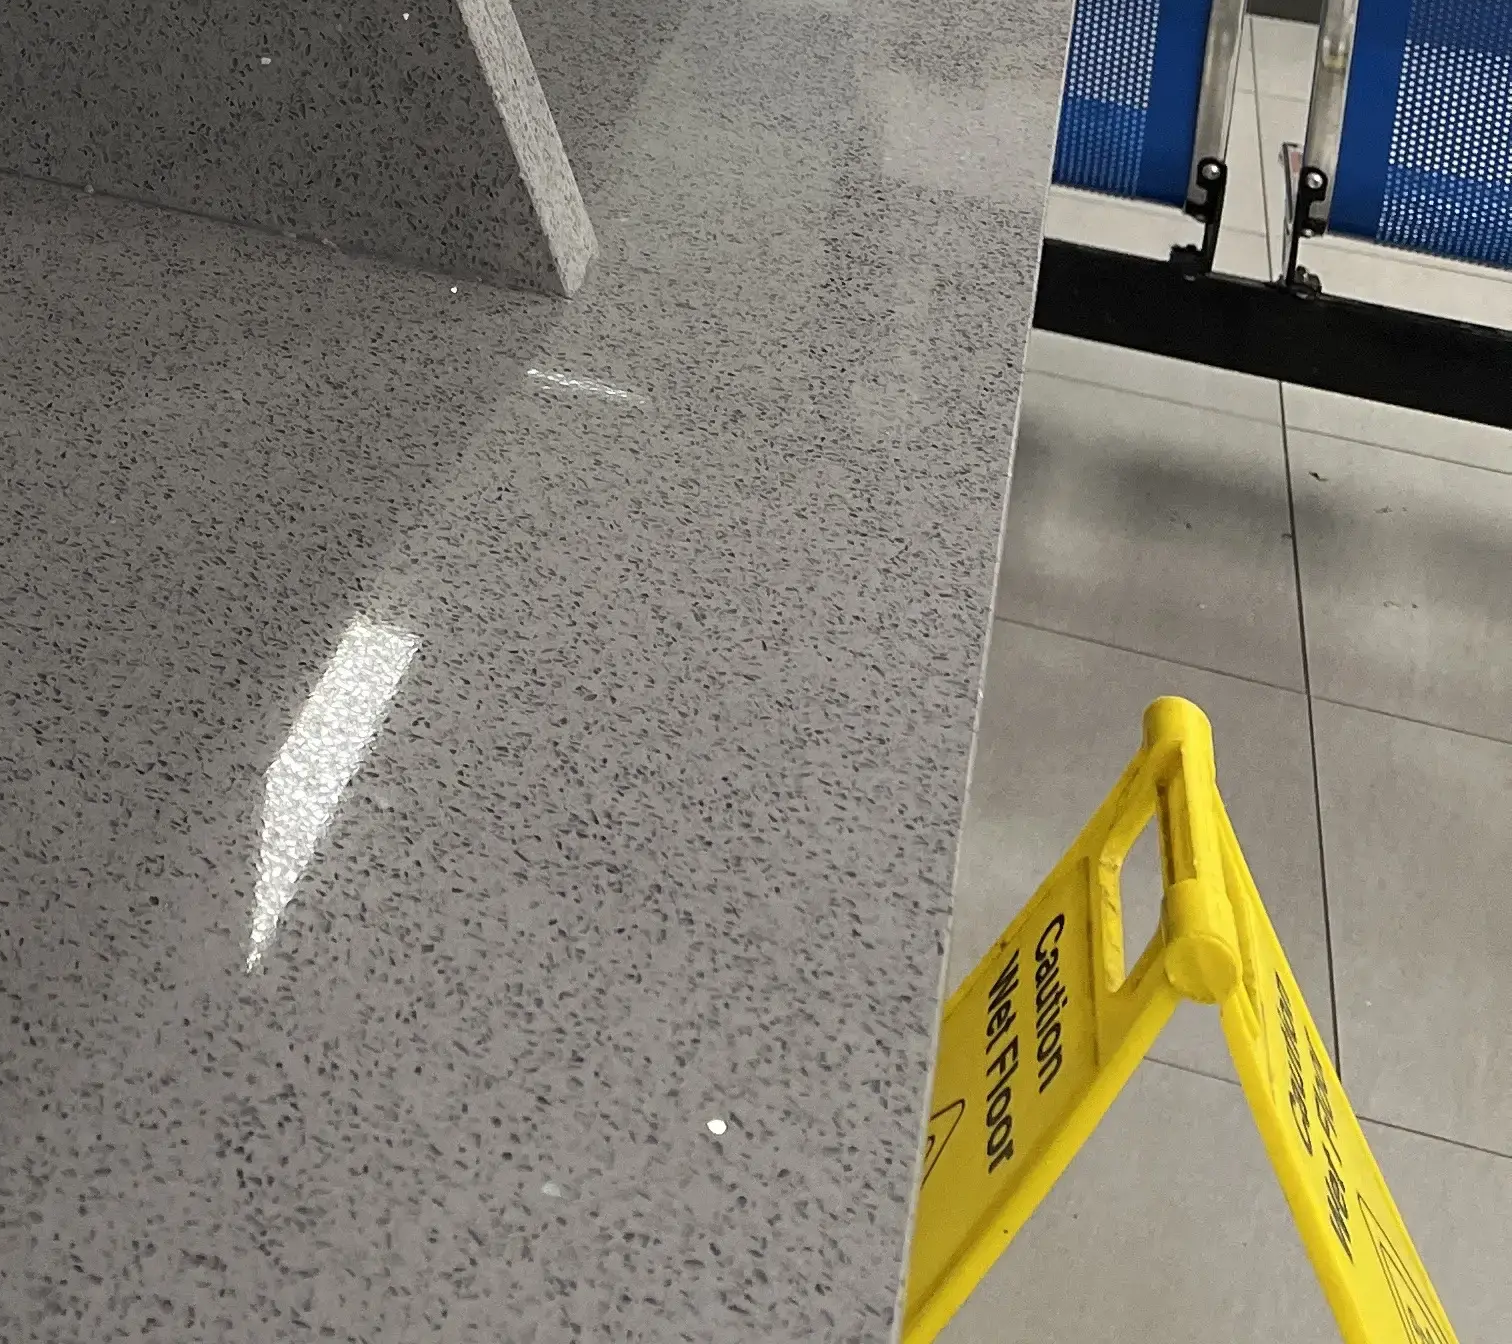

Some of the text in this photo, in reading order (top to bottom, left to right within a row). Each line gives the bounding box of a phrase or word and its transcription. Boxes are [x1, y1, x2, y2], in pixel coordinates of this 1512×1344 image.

[986, 948, 1020, 1175] Wet Floor
[1035, 913, 1068, 1094] Caution
[1275, 970, 1314, 1158] Caution
[1303, 1024, 1355, 1266] Wet Floor
